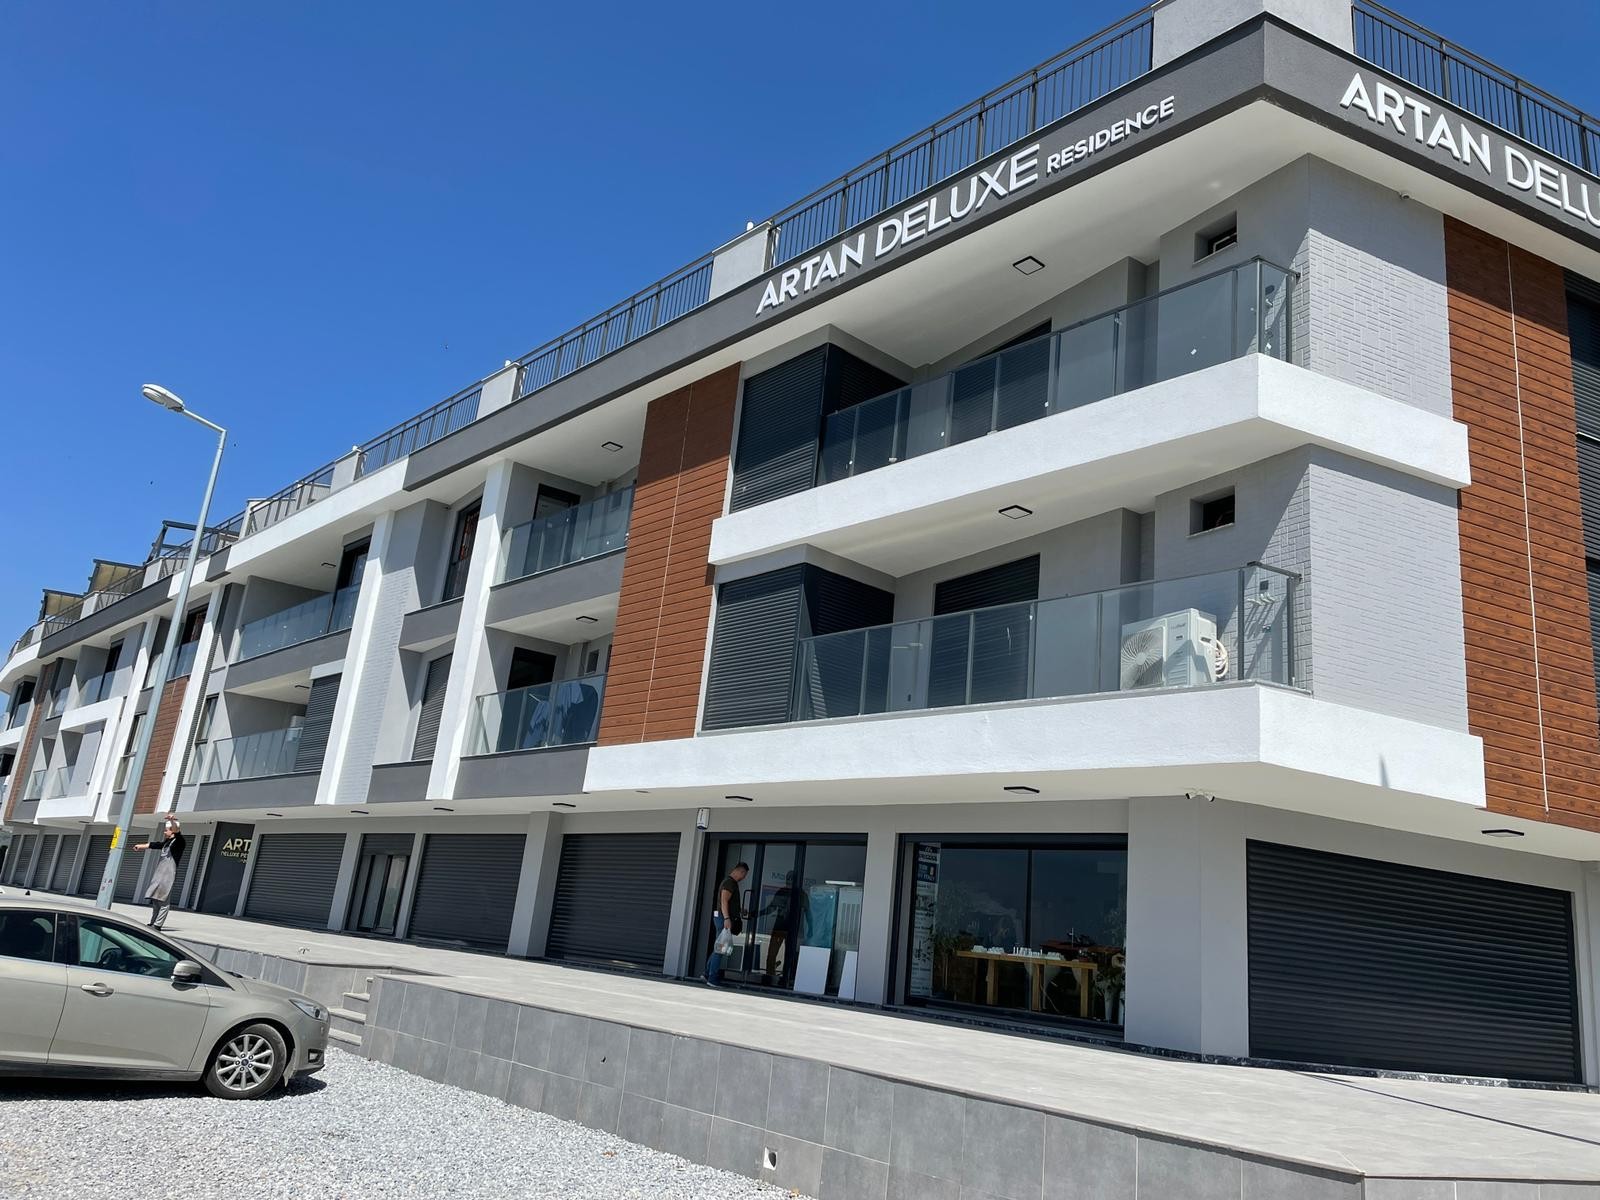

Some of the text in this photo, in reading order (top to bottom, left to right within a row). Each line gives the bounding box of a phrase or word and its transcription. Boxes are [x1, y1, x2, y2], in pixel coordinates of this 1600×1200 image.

[1340, 72, 1492, 175] ARTAN
[755, 95, 1176, 316] ARTAN DELUXE RESIDENCE
[222, 838, 252, 852] ART
